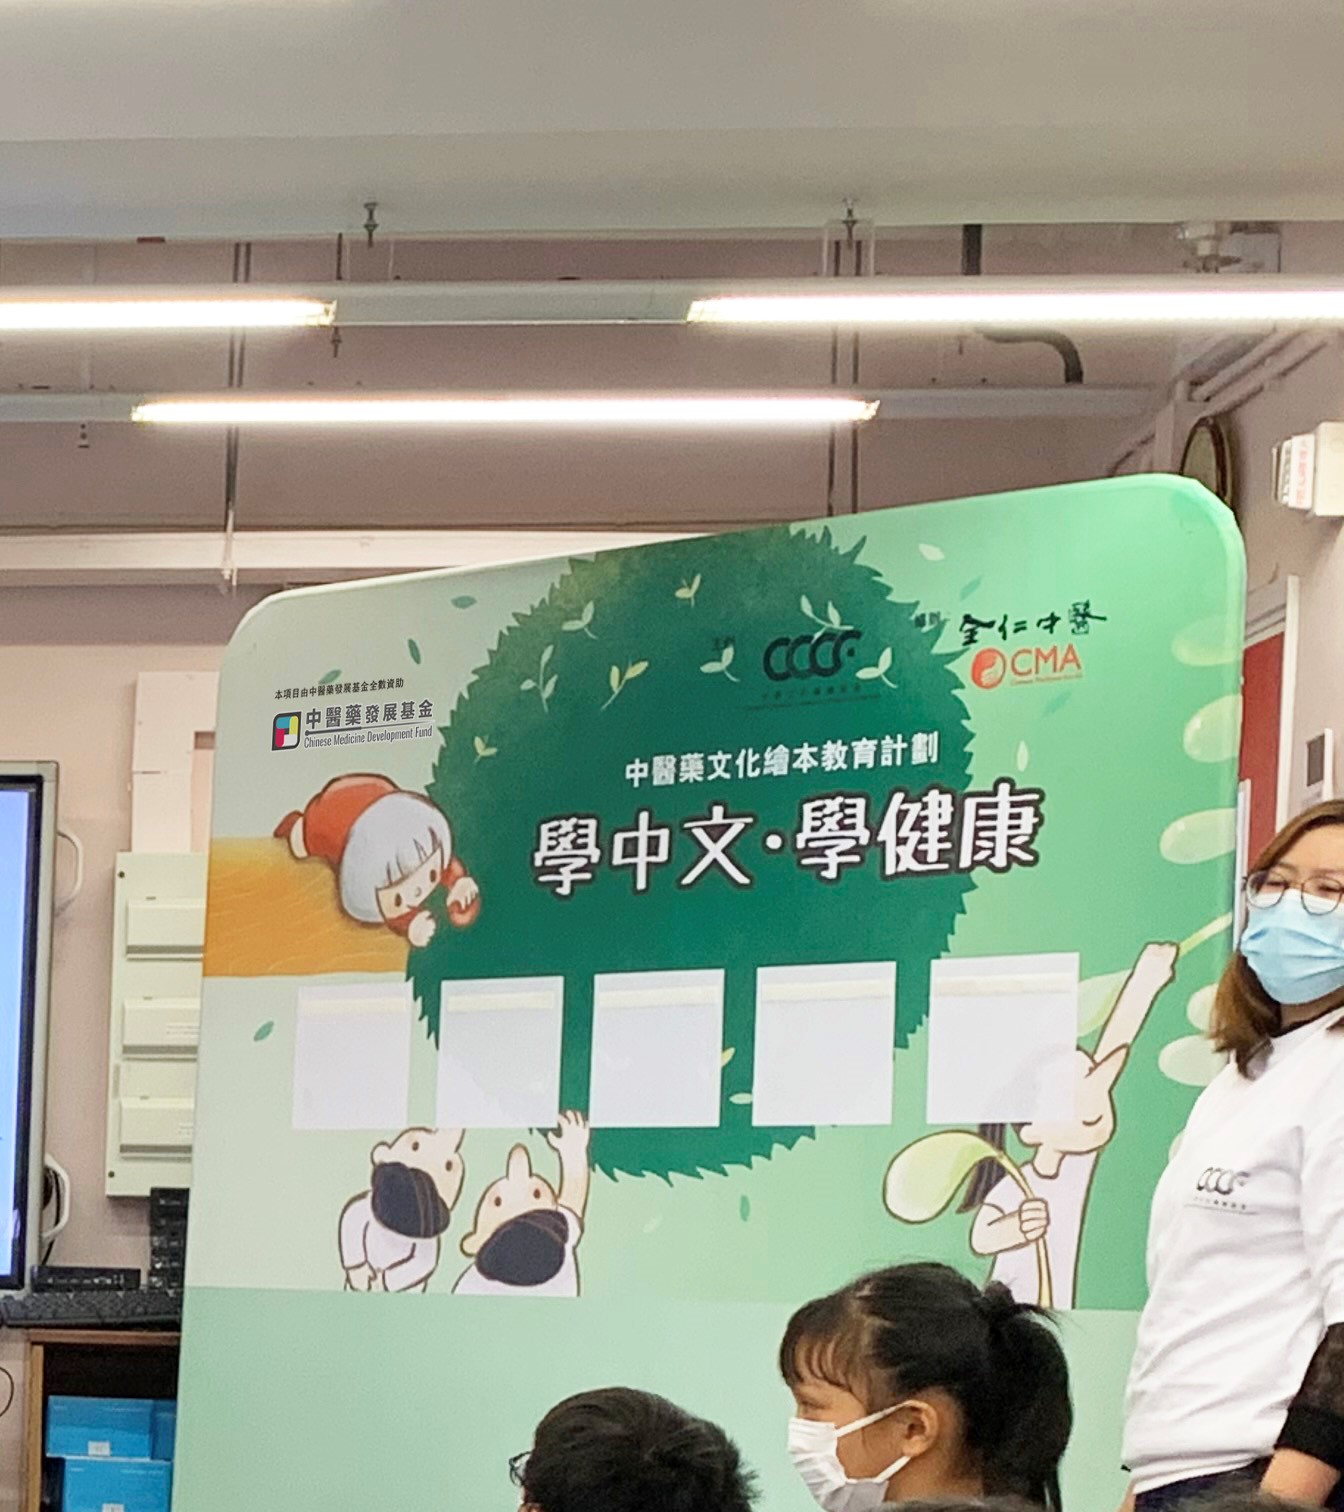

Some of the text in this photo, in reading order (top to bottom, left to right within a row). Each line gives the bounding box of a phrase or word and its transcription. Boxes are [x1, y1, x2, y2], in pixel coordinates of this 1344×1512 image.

[1010, 643, 1082, 677] CMA
[274, 677, 405, 700] 本項目由中醫藥發展基金全數資助
[305, 699, 434, 729] 中醫藥發展基金
[304, 725, 433, 749] Chinese Medicine Development Fund
[625, 731, 939, 789] 中醫藥文化繪本教育計劃
